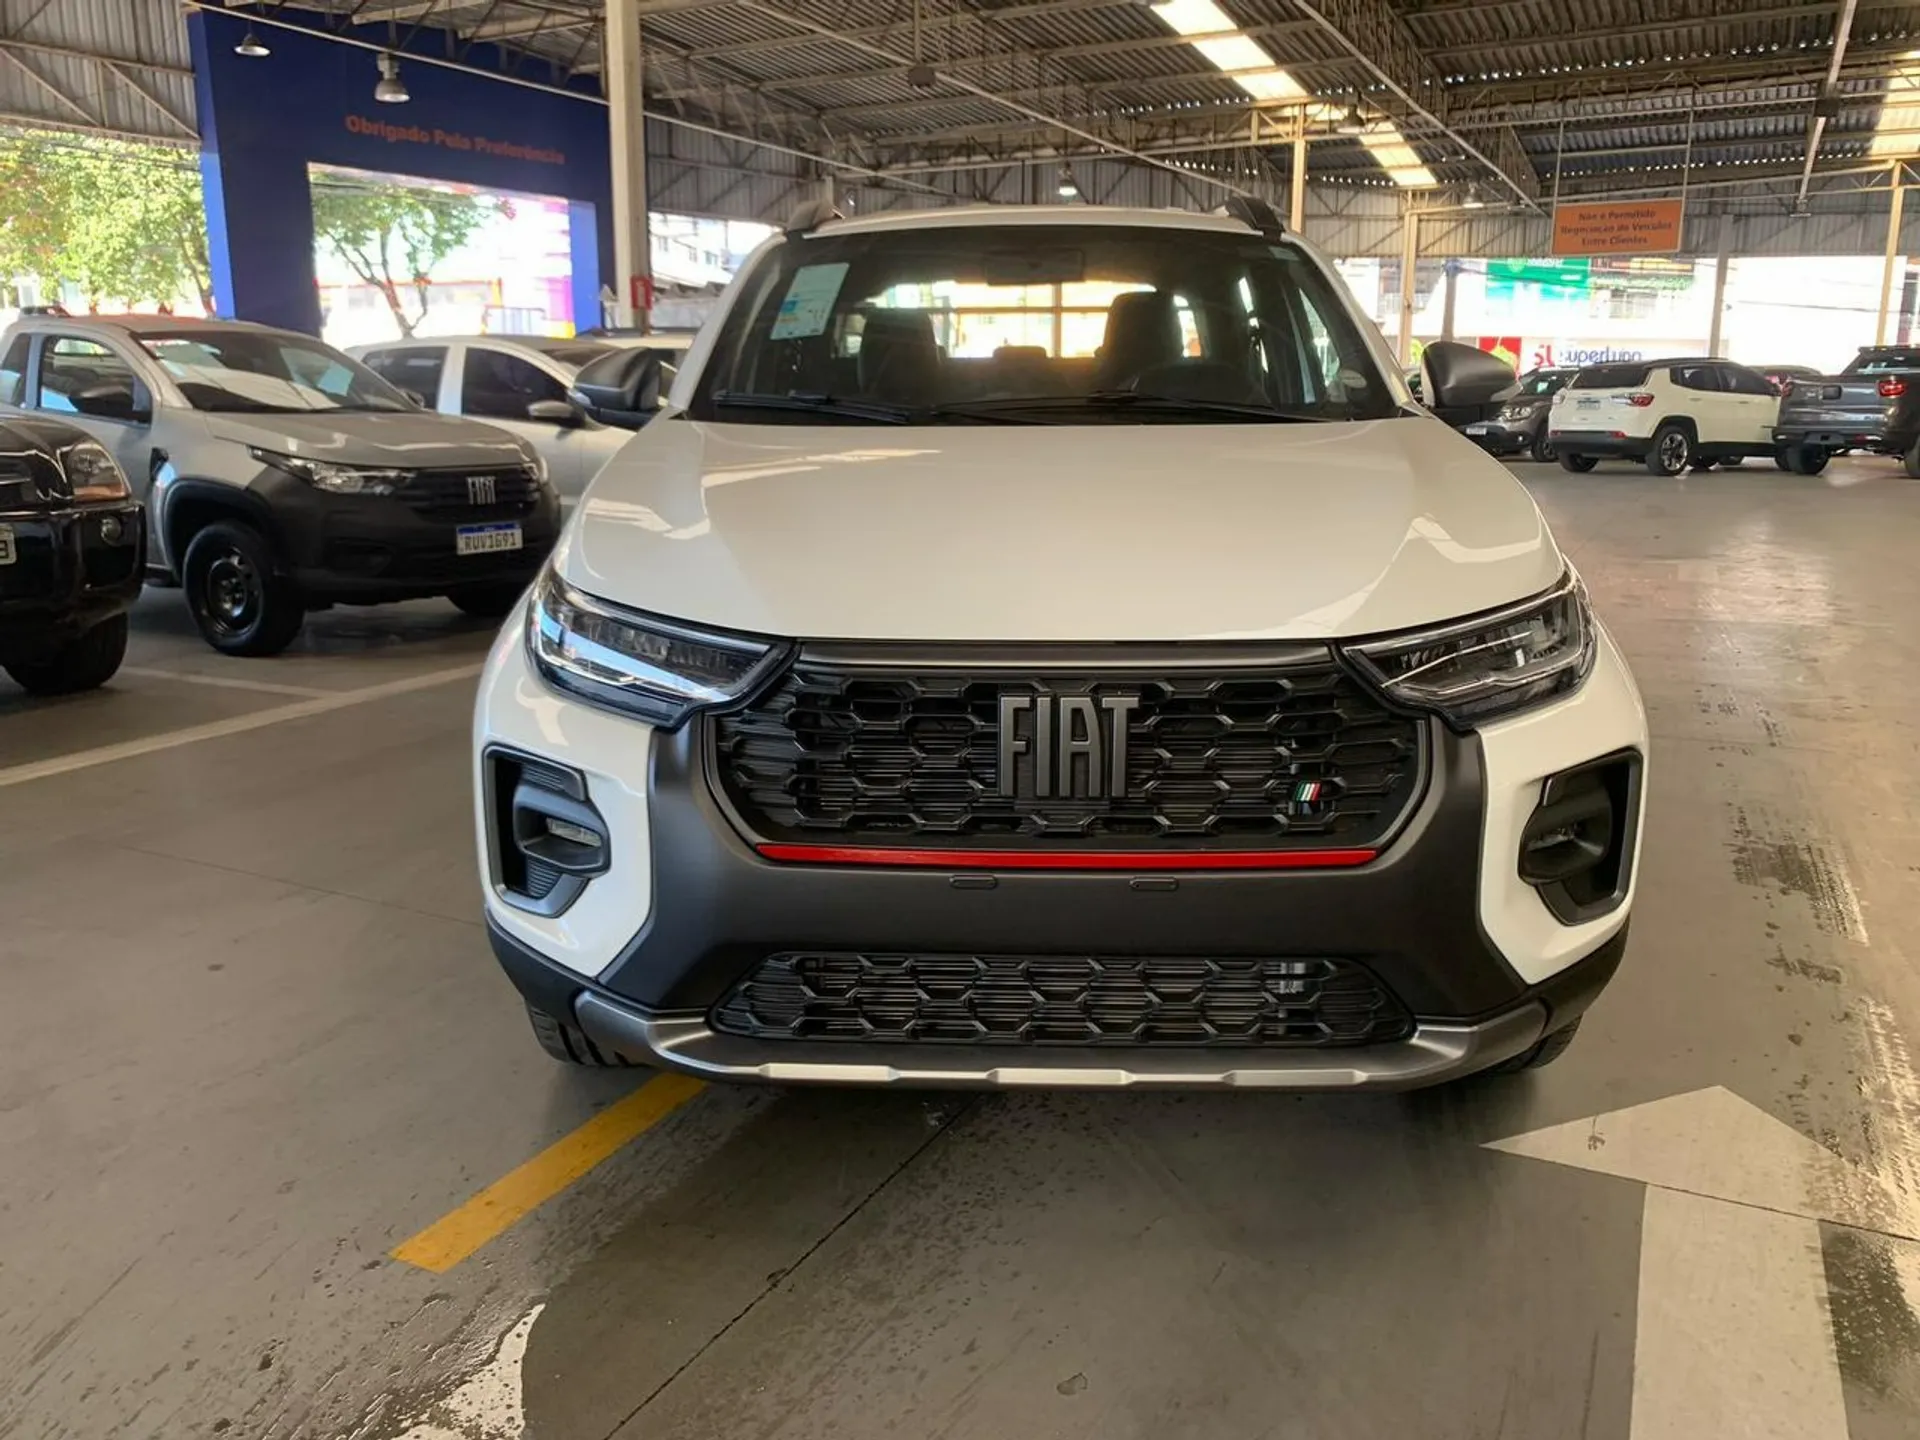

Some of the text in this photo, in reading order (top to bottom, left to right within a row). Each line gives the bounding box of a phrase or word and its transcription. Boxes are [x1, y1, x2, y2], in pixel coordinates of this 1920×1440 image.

[344, 114, 430, 143] Obrigado
[434, 129, 471, 150] Pela
[1578, 212, 1598, 221] Não
[1608, 208, 1656, 219] Permitido
[1617, 223, 1629, 232] de
[1581, 235, 1648, 247] Entre Clientes
[464, 531, 517, 551] RUV1G91
[999, 693, 1141, 799] FIAT
